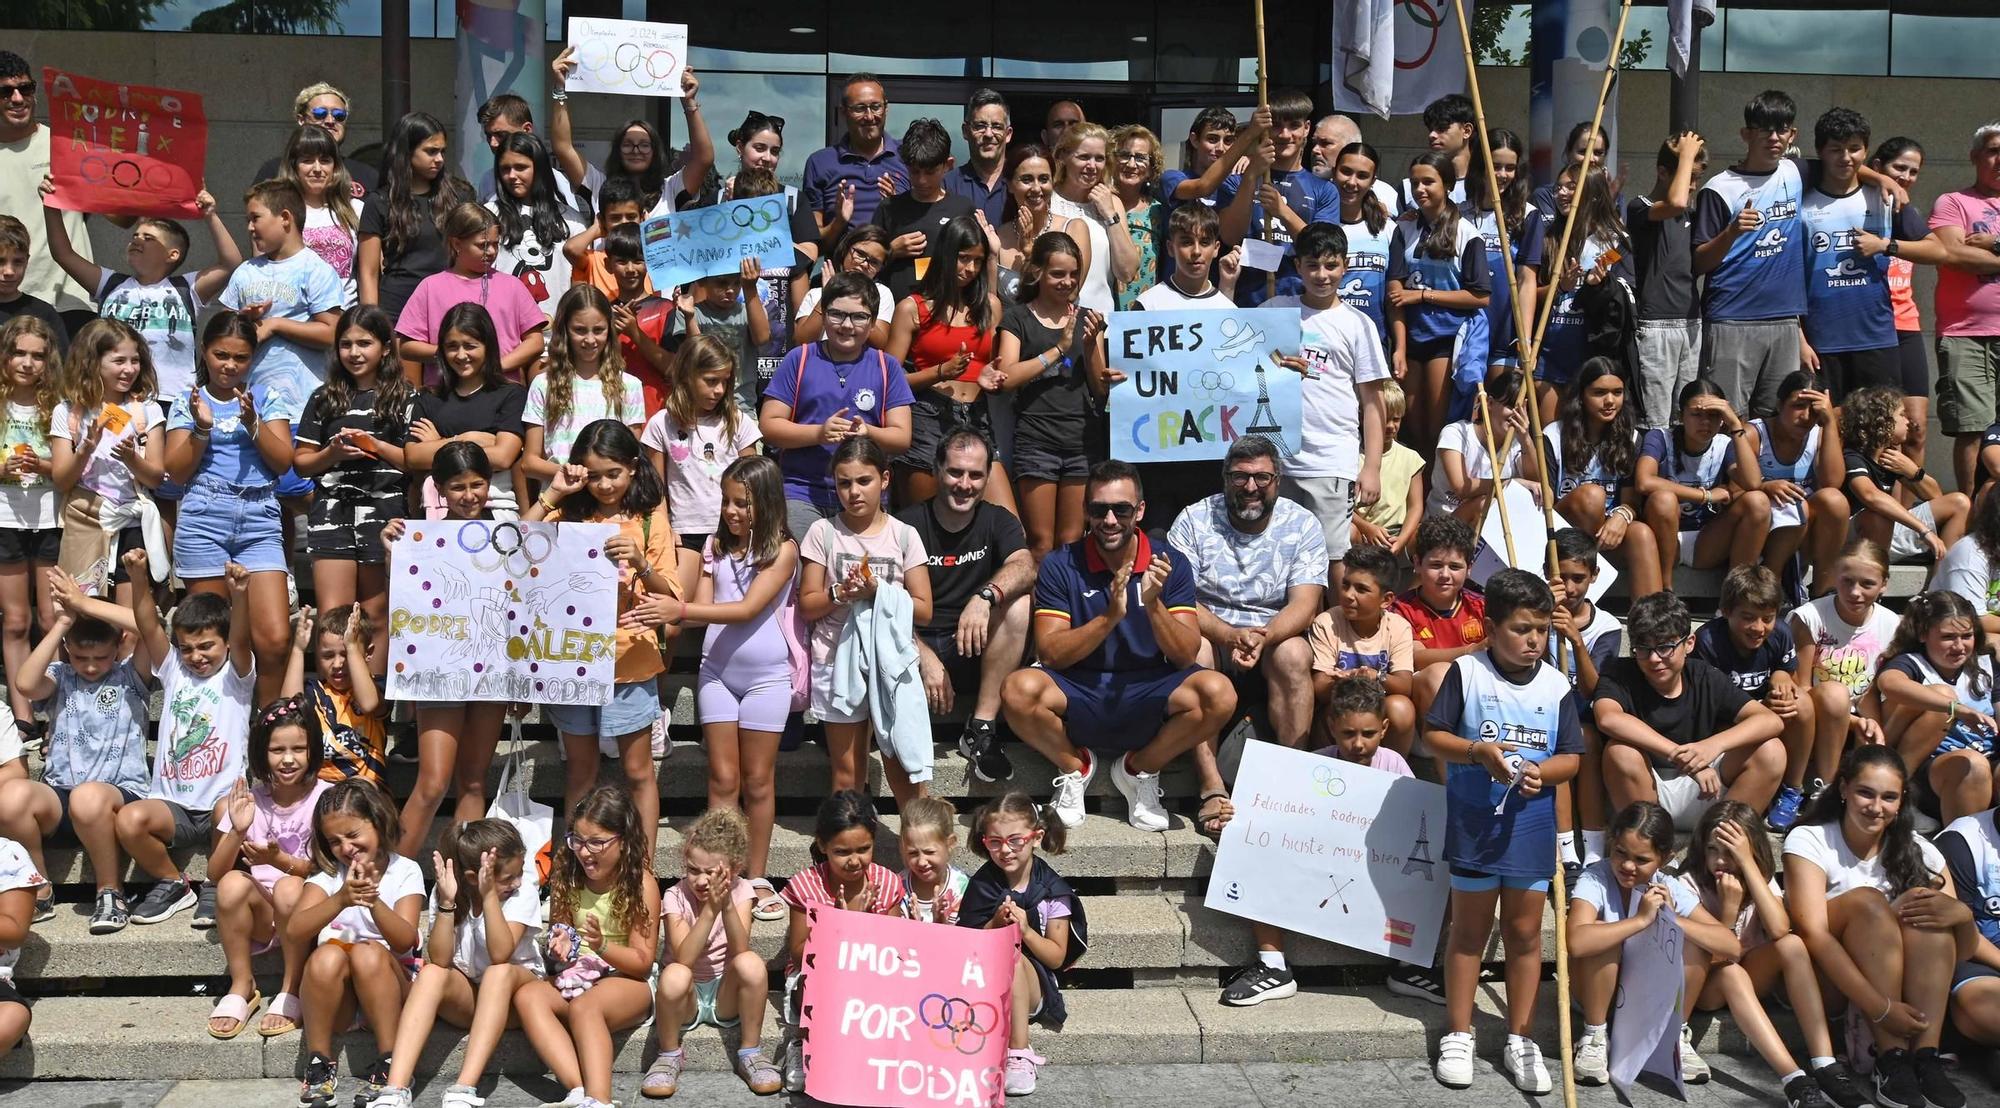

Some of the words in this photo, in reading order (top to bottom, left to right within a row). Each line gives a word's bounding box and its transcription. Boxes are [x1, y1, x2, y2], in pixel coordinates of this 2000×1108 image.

[628, 26, 657, 40] 2024
[678, 246, 733, 267] VAMOS
[1827, 277, 1868, 288] PEREIRA
[1345, 297, 1370, 307] REIRA
[1123, 322, 1204, 360] ERES
[1135, 370, 1178, 398] UN
[1131, 404, 1240, 453] CRACK
[388, 607, 471, 643] RODRI
[179, 742, 228, 780] GLORY
[176, 784, 194, 793] BRO
[1252, 793, 1316, 816] Felicidades
[1332, 845, 1363, 866] muy
[1371, 848, 1400, 866] bien
[838, 941, 921, 979] IMOS
[840, 998, 917, 1042] POR
